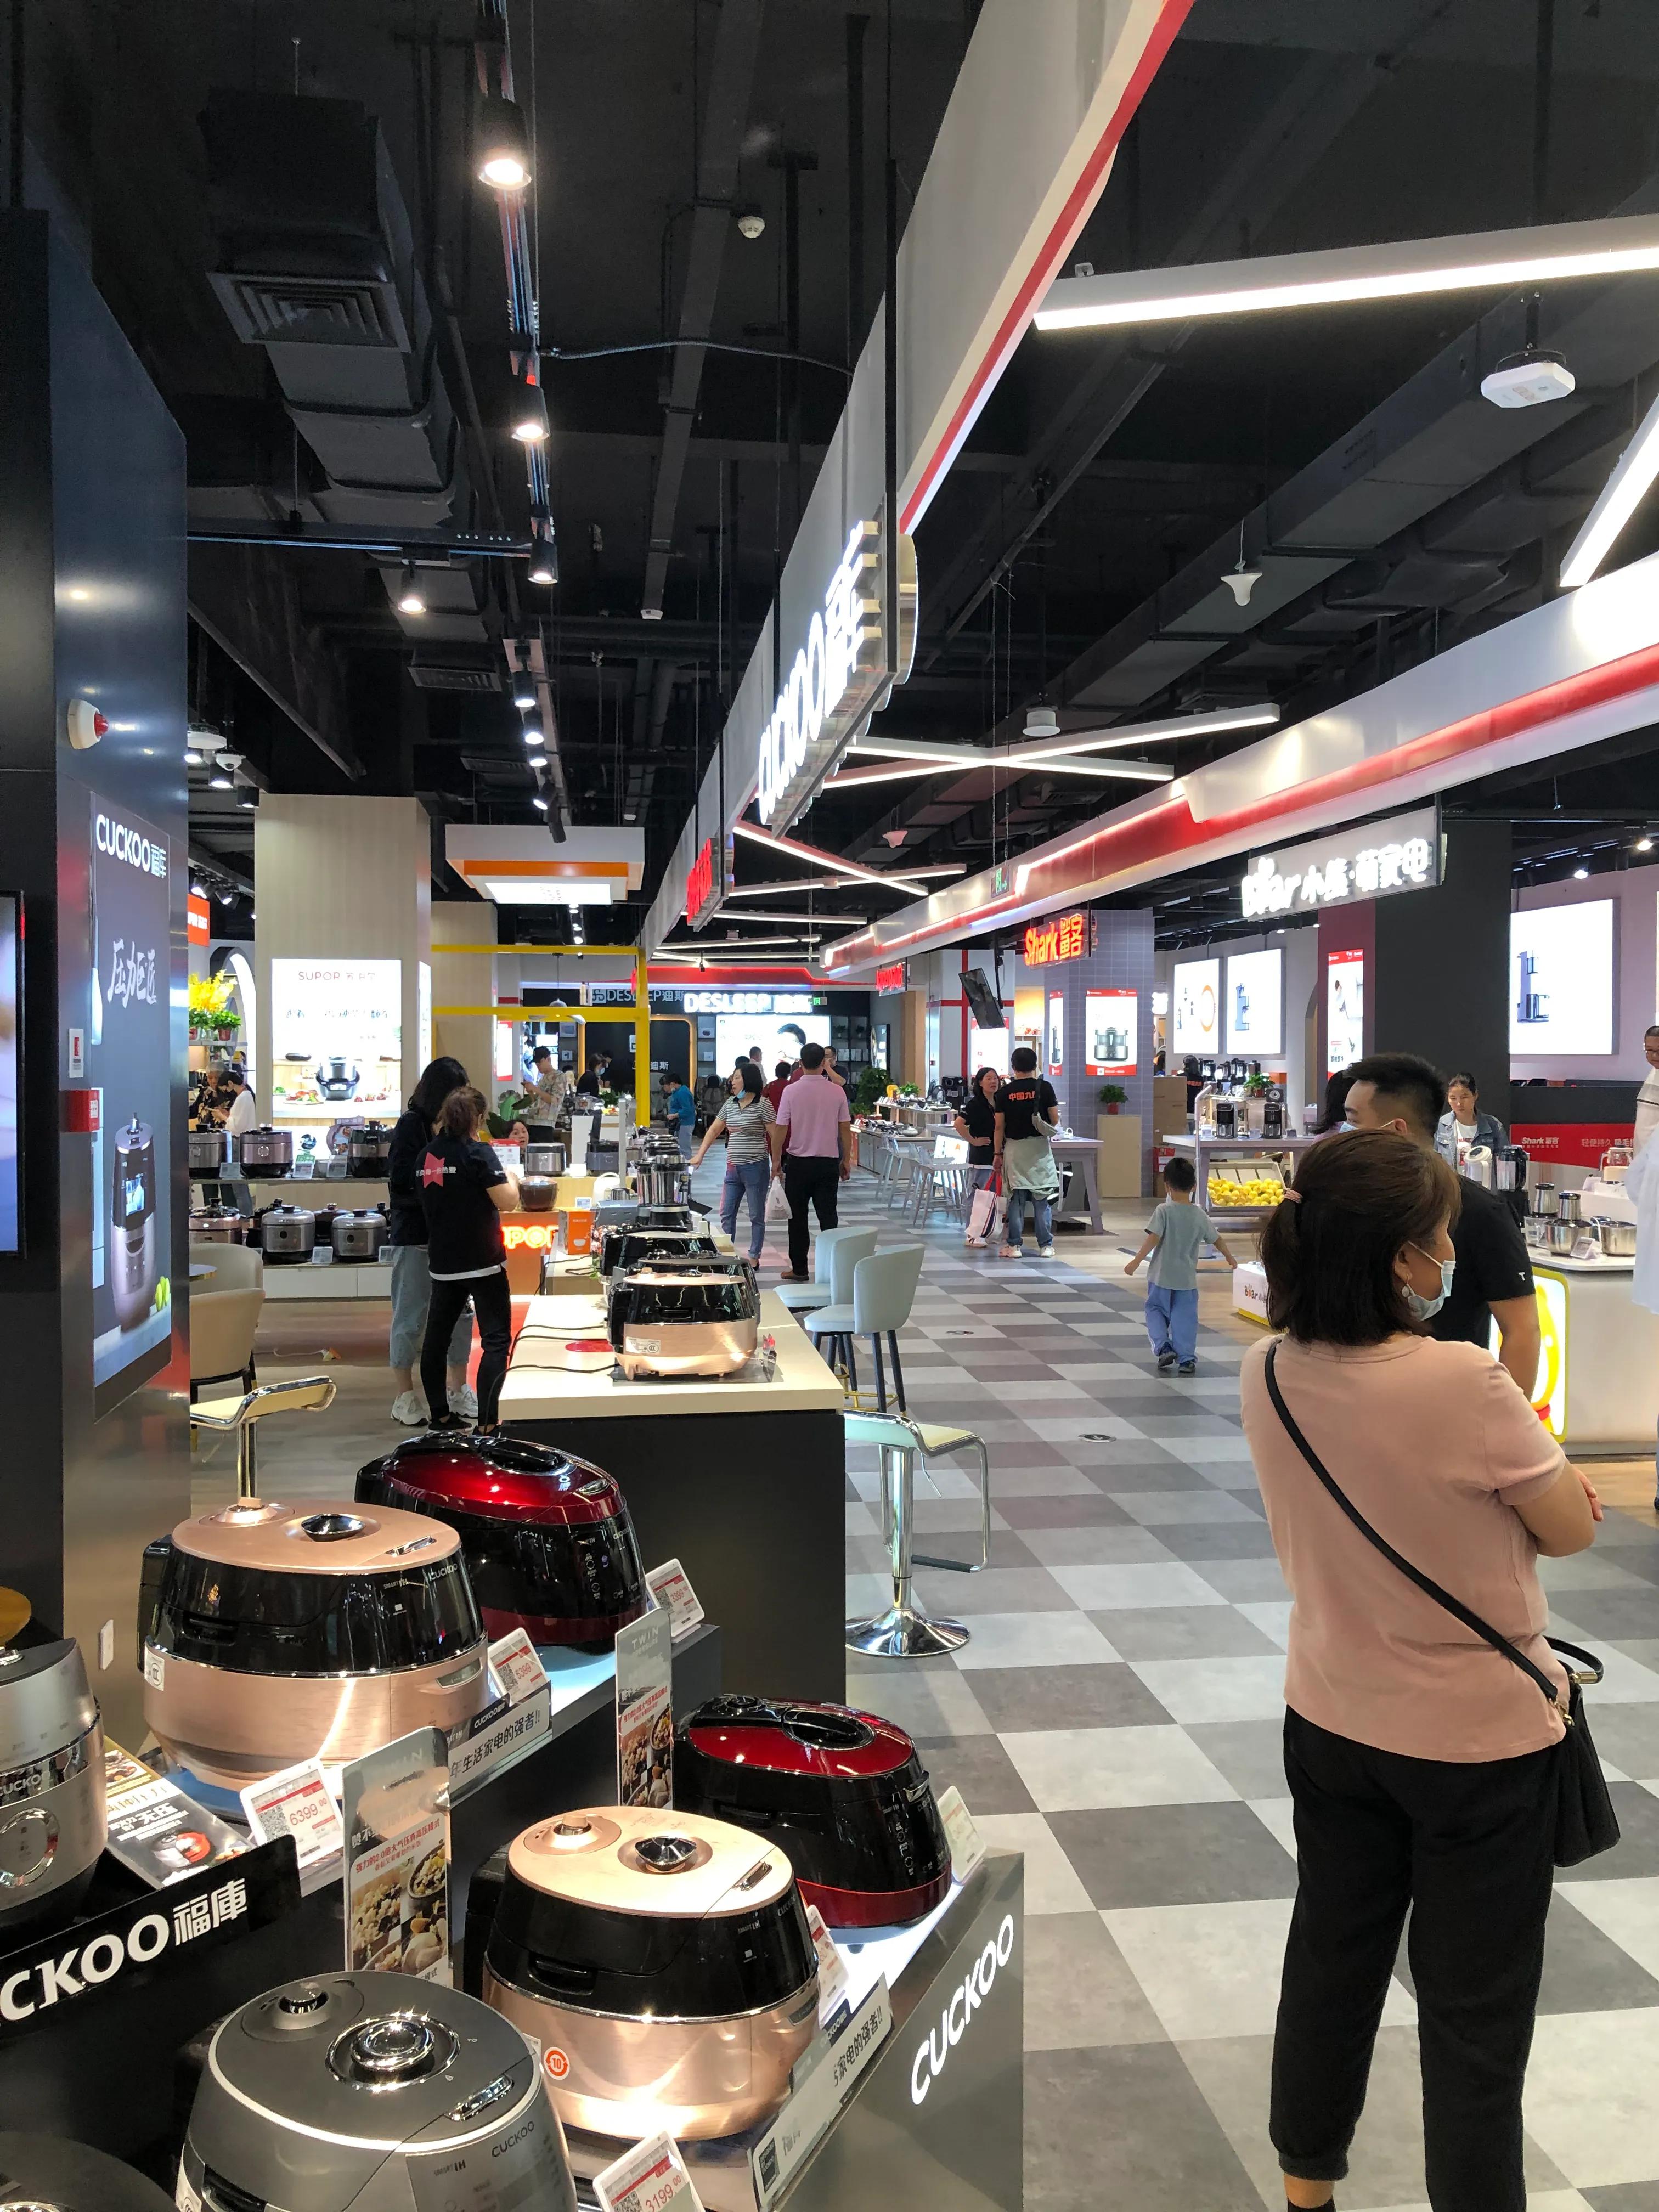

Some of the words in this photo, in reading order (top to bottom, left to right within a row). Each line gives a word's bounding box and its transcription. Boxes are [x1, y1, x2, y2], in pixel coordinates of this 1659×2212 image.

[96, 814, 151, 872] CUCKOO
[1025, 922, 1059, 966] Shark
[298, 972, 340, 980] SUPOR
[431, 1563, 458, 1581] CUCKOO
[631, 1626, 658, 1650] TWIN
[474, 1708, 498, 1729] CUCKOO
[290, 1803, 318, 1826] 6399
[0, 1914, 170, 2021] CKOO
[911, 1914, 1014, 2105] CUCKOO
[552, 2057, 562, 2069] 10
[491, 2121, 534, 2158] CUCKOO
[645, 2184, 674, 2212] 3199
